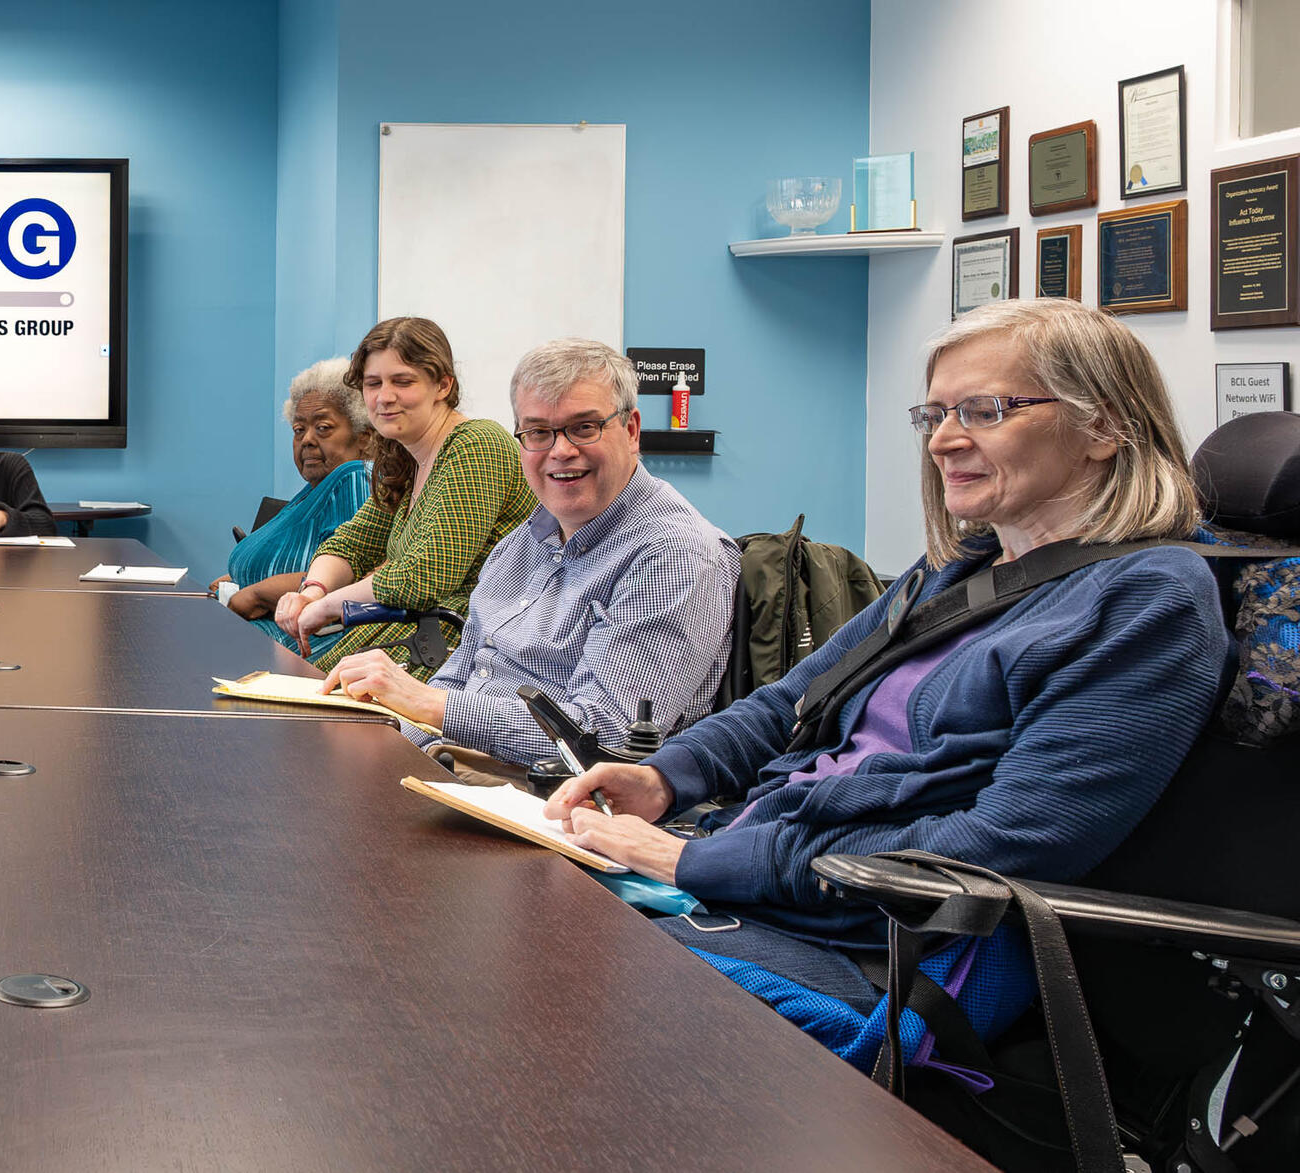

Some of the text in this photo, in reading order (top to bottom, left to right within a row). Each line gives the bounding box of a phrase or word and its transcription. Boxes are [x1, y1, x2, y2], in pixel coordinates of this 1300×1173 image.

[1239, 207, 1264, 216] Act Today
[1228, 214, 1276, 226] Influence Tomorrow
[15, 319, 74, 336] GROUP
[637, 361, 696, 370] Please Erase
[661, 372, 699, 381] Finied
[1230, 377, 1270, 387] BCIL Guest
[1225, 393, 1277, 403] Network WiFi
